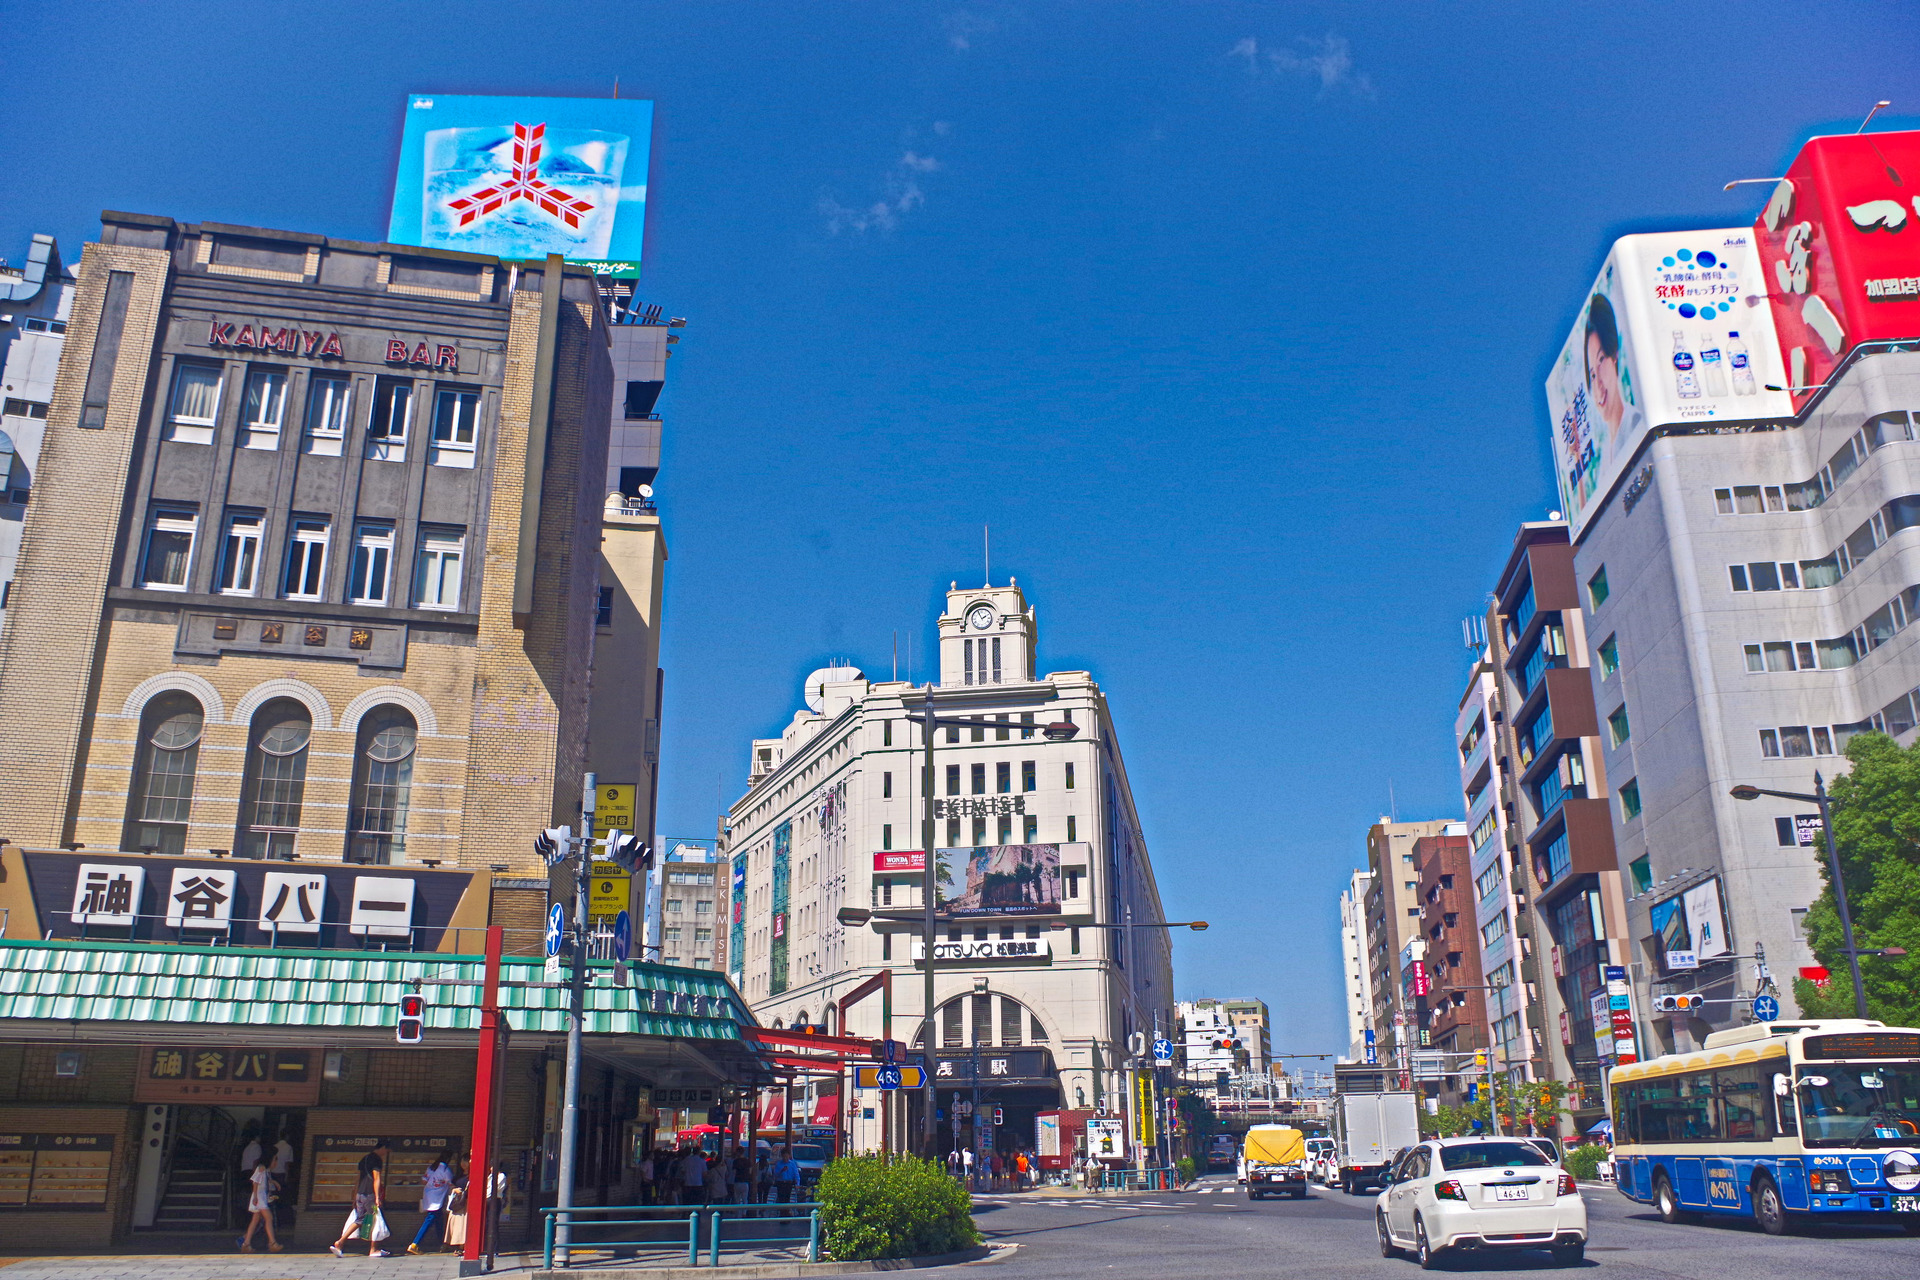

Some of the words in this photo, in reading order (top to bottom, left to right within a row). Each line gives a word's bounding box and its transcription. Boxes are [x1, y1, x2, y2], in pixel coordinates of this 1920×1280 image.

[1655, 284, 1739, 298] 発酵がもつチカラ
[208, 320, 344, 357] KAMIYA
[384, 337, 458, 369] BAR
[934, 795, 1025, 820] EKIMISE
[80, 871, 407, 923] 神谷バー
[717, 876, 728, 963] EKIMISE
[152, 1051, 304, 1079] 神谷バー
[936, 1060, 1008, 1076] 浅駅
[878, 1071, 900, 1084] 463
[1813, 1157, 1843, 1165] めぐりん
[1503, 1189, 1526, 1198] 46-49
[1710, 1181, 1737, 1200] めぐりん
